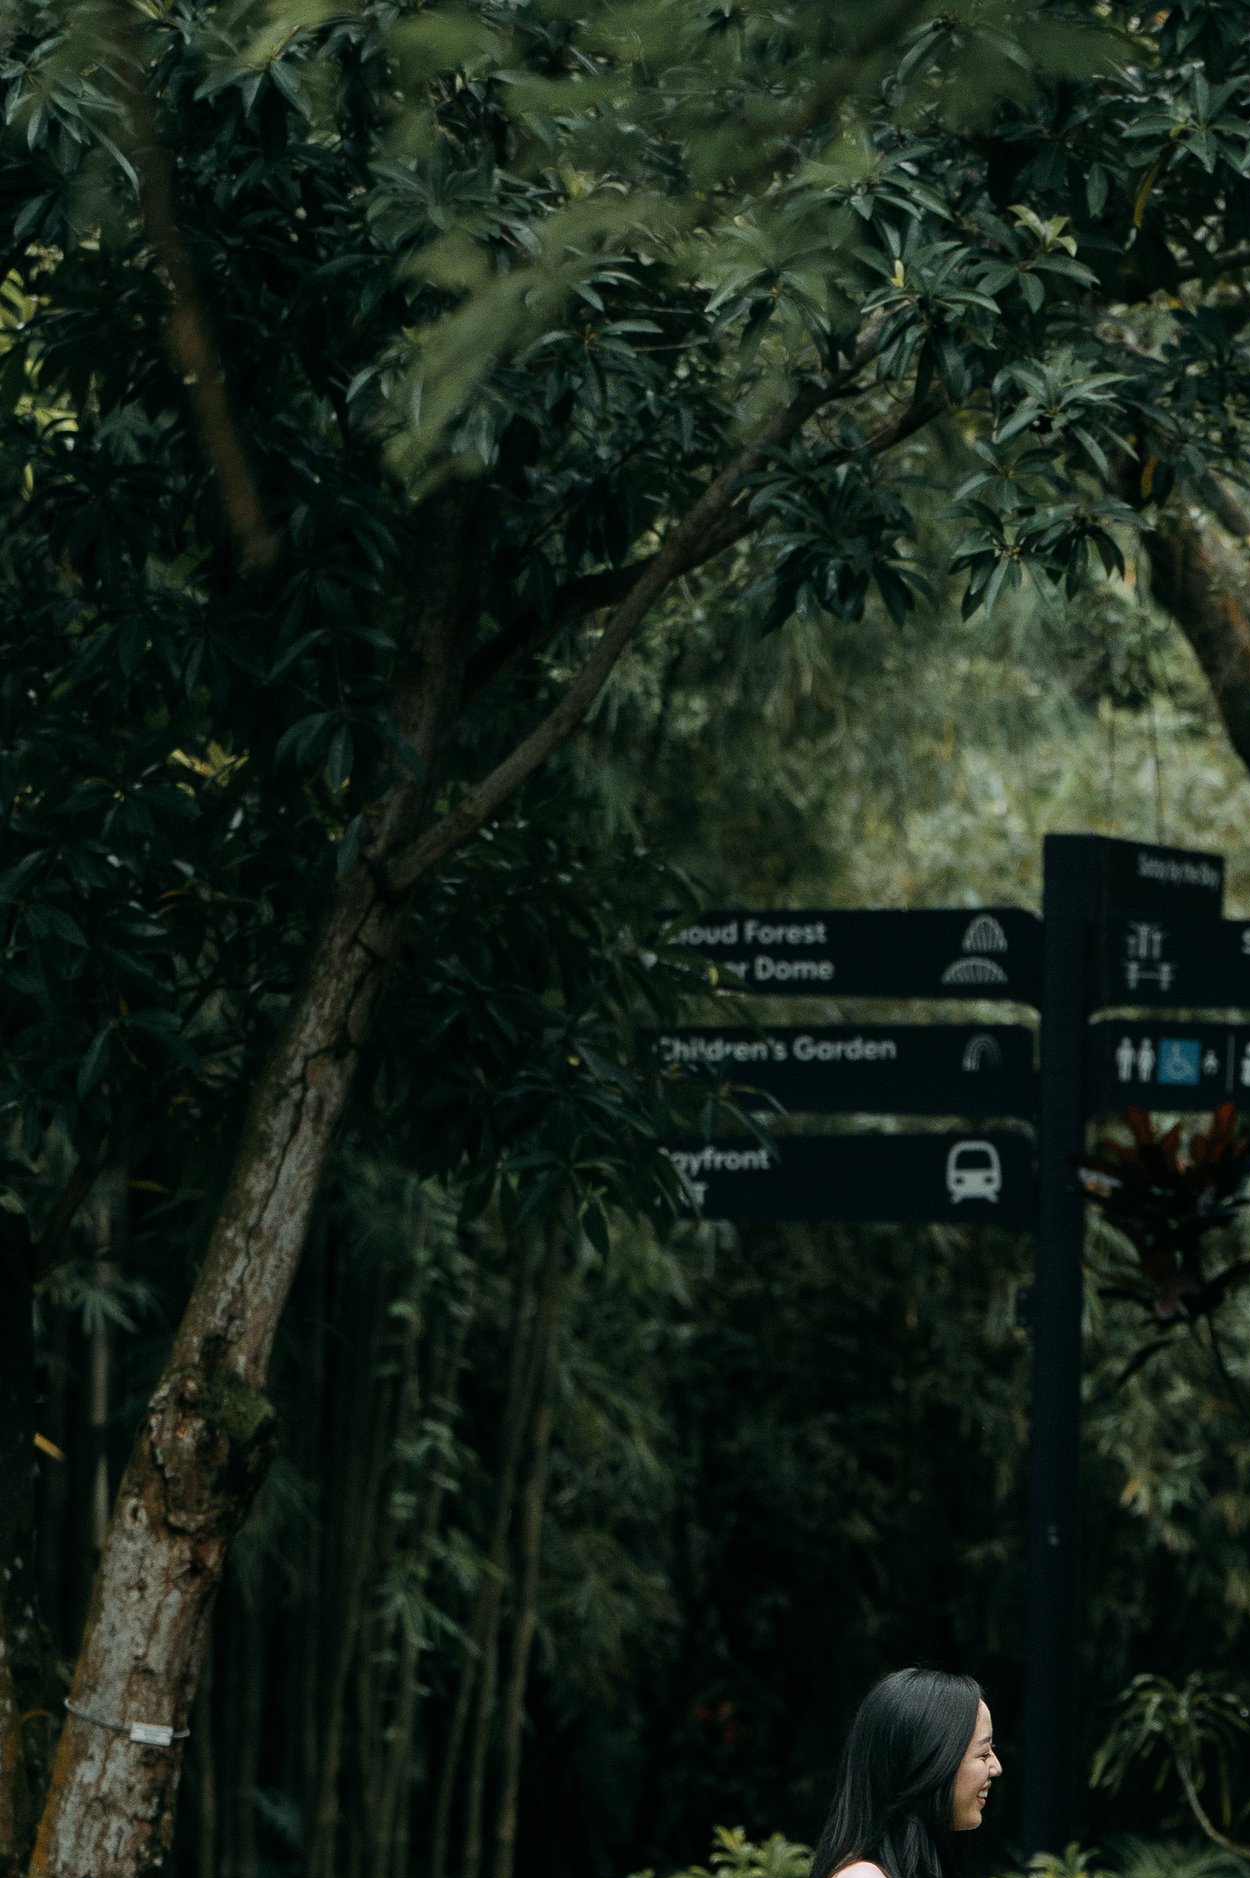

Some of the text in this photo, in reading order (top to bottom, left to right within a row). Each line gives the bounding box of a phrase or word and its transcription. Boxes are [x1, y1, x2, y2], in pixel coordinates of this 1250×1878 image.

[744, 918, 827, 945] Forest
[753, 955, 835, 981] Dome
[793, 1034, 897, 1061] Garden
[657, 1145, 770, 1178] ayfront
